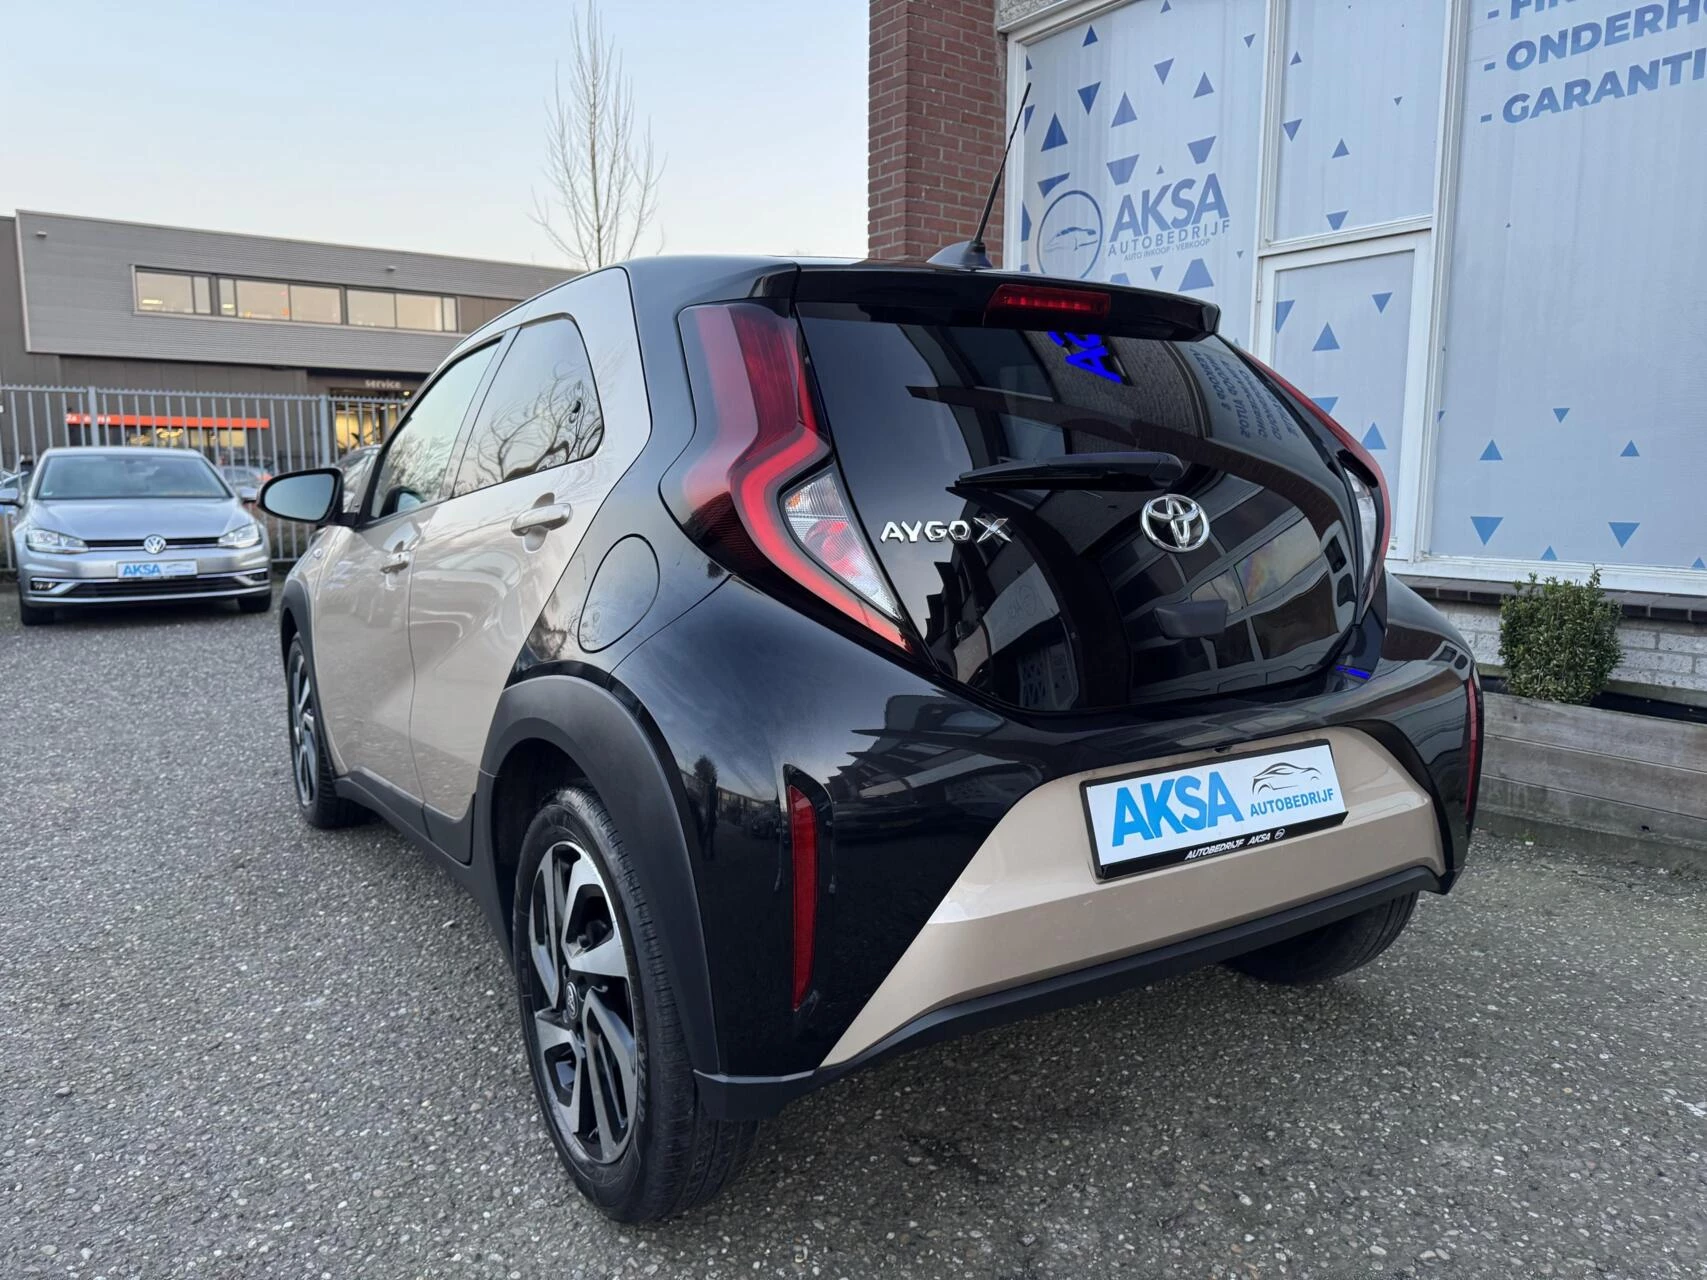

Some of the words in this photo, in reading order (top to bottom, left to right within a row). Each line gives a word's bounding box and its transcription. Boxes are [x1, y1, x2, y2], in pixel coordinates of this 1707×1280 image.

[1506, 0, 1707, 71] ONDERH
[1502, 47, 1707, 124] GARANTI
[1109, 173, 1230, 243] AKSA
[1108, 219, 1230, 257] AUTOBEDRIJF
[880, 520, 971, 543] AYGO
[973, 517, 1013, 543] X
[123, 564, 160, 576] AKSA
[1112, 771, 1244, 847] AKSA
[1250, 788, 1334, 817] AUTOBEDRIJF
[1185, 838, 1245, 860] AUTOBEDRIJF
[1247, 832, 1271, 846] AKSA
